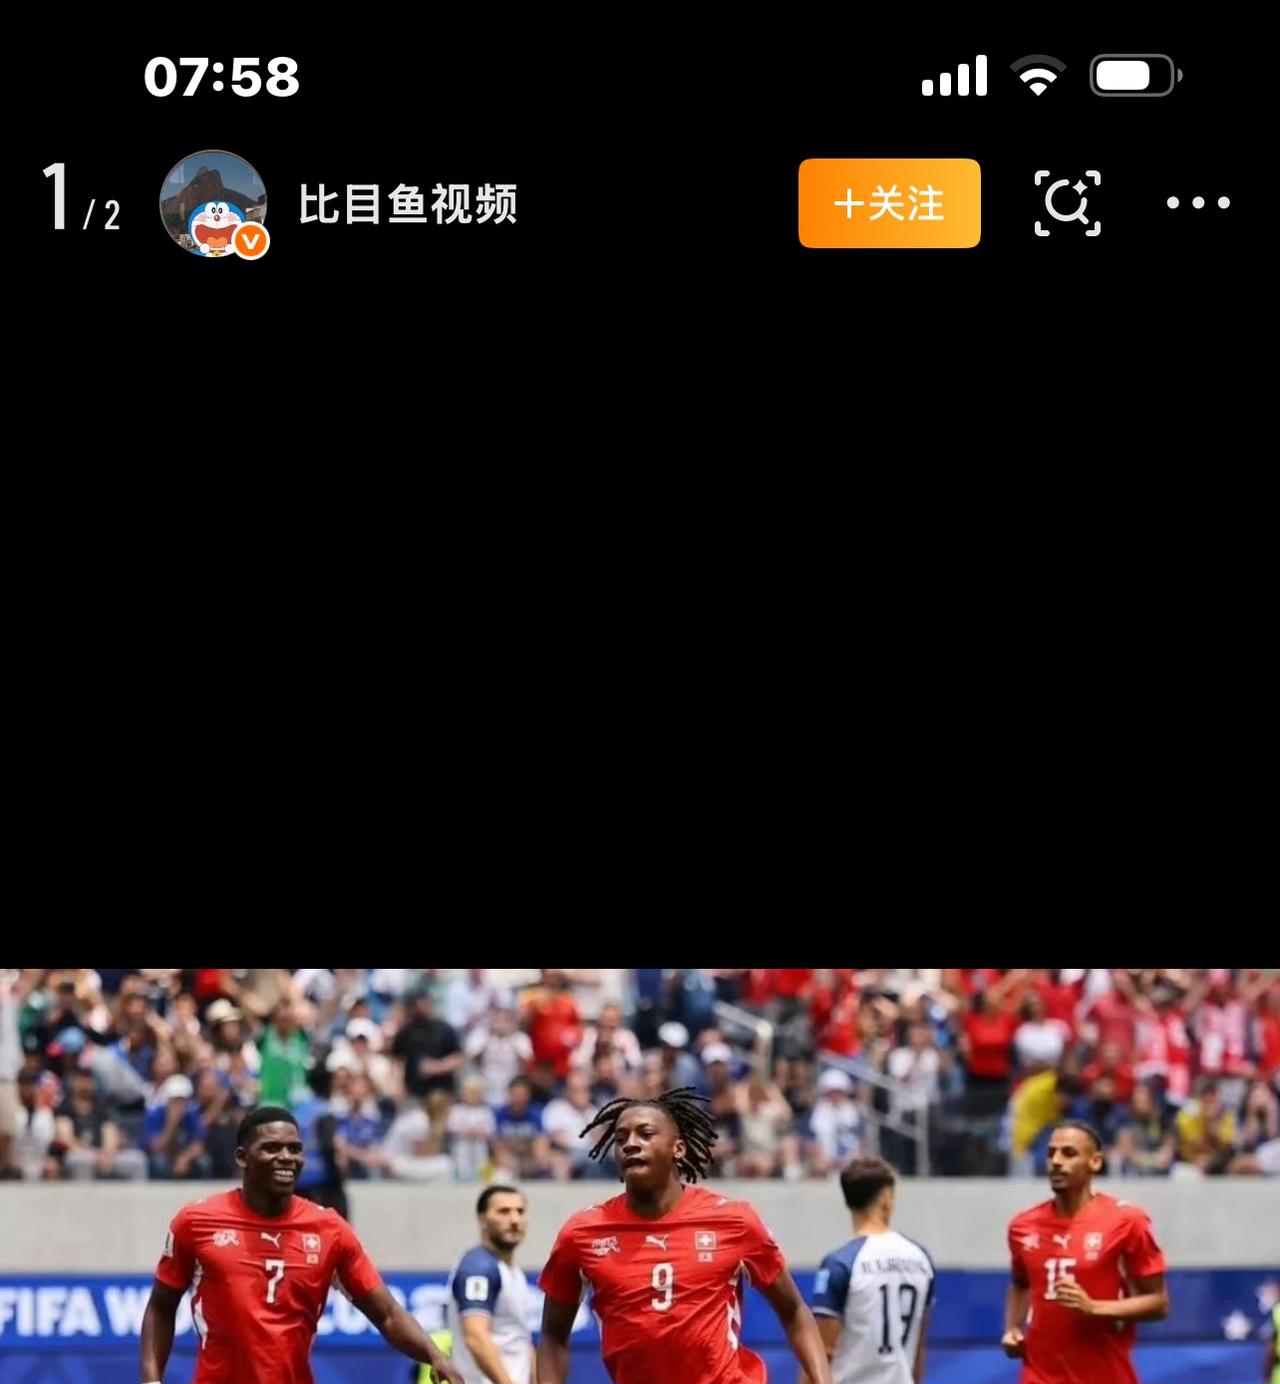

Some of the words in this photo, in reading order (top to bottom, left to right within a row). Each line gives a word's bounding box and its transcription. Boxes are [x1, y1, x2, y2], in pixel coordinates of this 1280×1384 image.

[265, 1259, 285, 1304] 7
[651, 1263, 674, 1311] 9
[878, 1284, 917, 1355] 19
